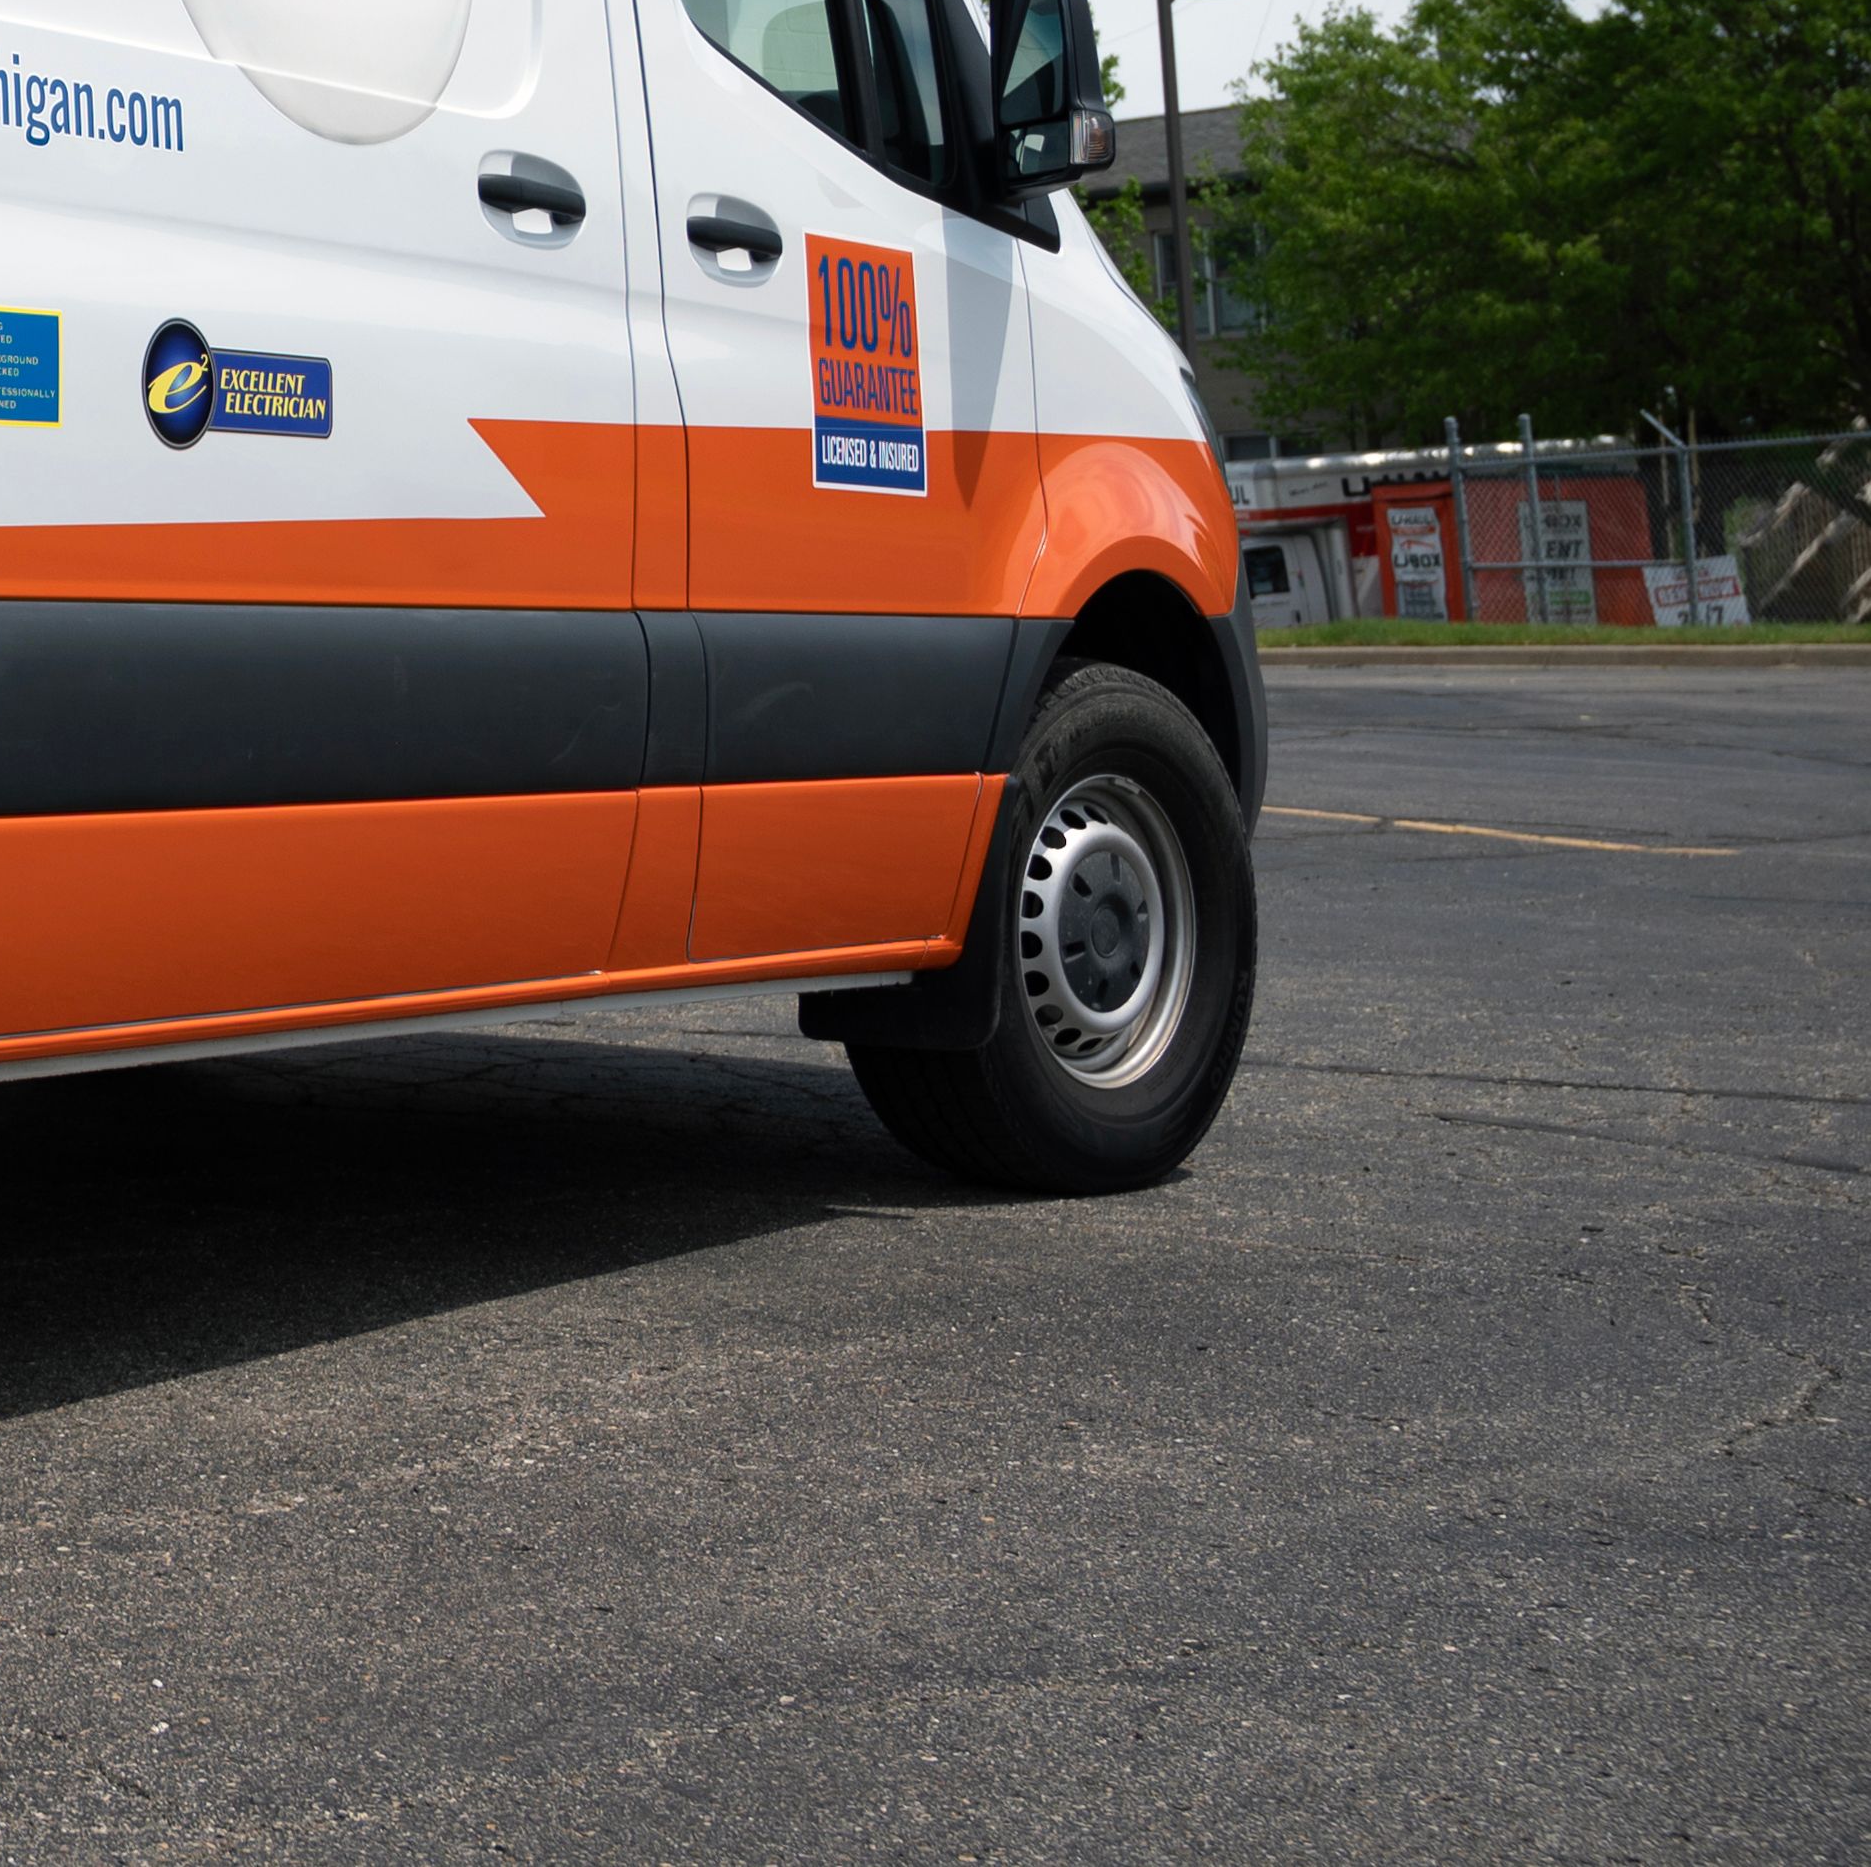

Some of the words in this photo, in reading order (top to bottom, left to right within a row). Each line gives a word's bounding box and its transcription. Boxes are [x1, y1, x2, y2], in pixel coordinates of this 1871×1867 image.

[818, 254, 912, 358] 100%
[220, 368, 306, 396] EXCELLENT
[818, 357, 918, 416] GUARANTEE
[224, 392, 326, 420] ELECTRICIAN
[821, 434, 867, 468] LICENSED
[869, 443, 878, 470] &
[878, 440, 920, 473] INSURED
